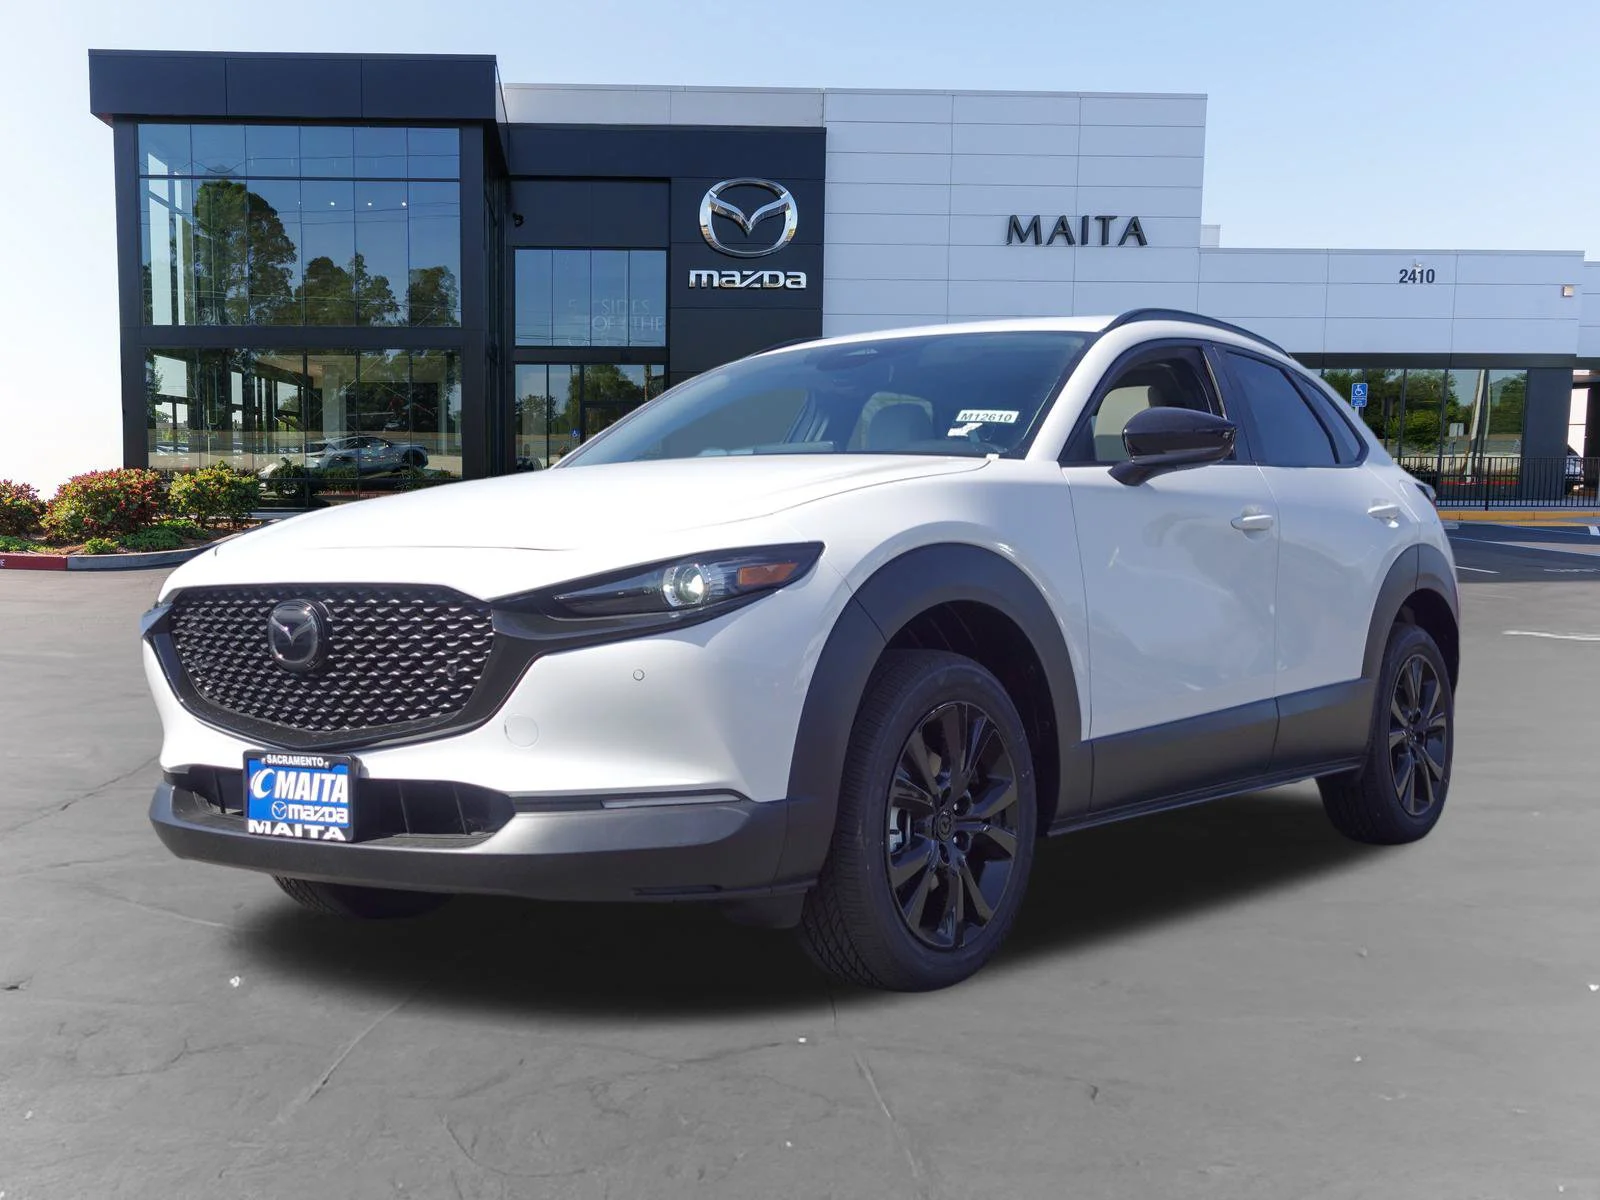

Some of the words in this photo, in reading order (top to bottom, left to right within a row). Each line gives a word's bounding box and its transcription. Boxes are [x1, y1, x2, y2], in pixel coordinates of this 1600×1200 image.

[1006, 214, 1148, 246] MAITA
[1399, 268, 1436, 284] 2410
[960, 412, 1013, 422] M12610
[266, 754, 324, 767] SACRAMENTO
[248, 819, 346, 841] MAITA
